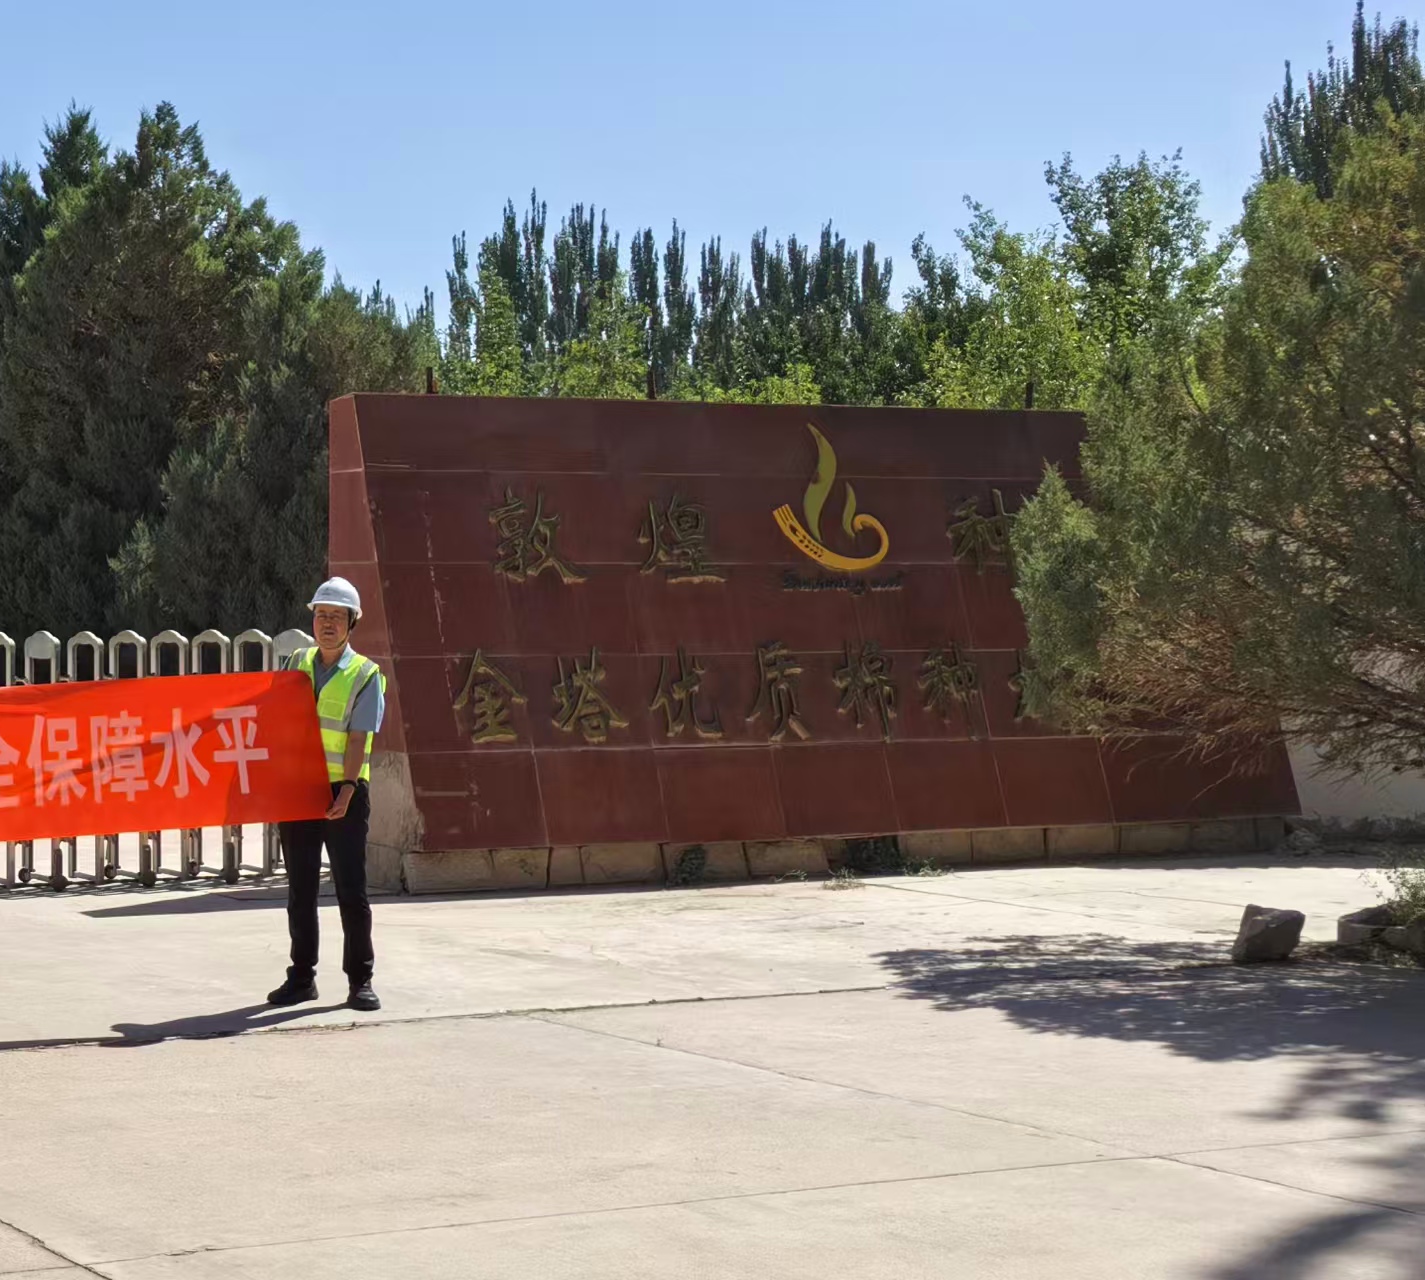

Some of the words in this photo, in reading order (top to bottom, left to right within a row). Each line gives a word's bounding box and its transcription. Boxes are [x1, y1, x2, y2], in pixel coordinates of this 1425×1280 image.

[487, 485, 727, 585] 敦煌
[452, 645, 1028, 743] 金塔优质棉种
